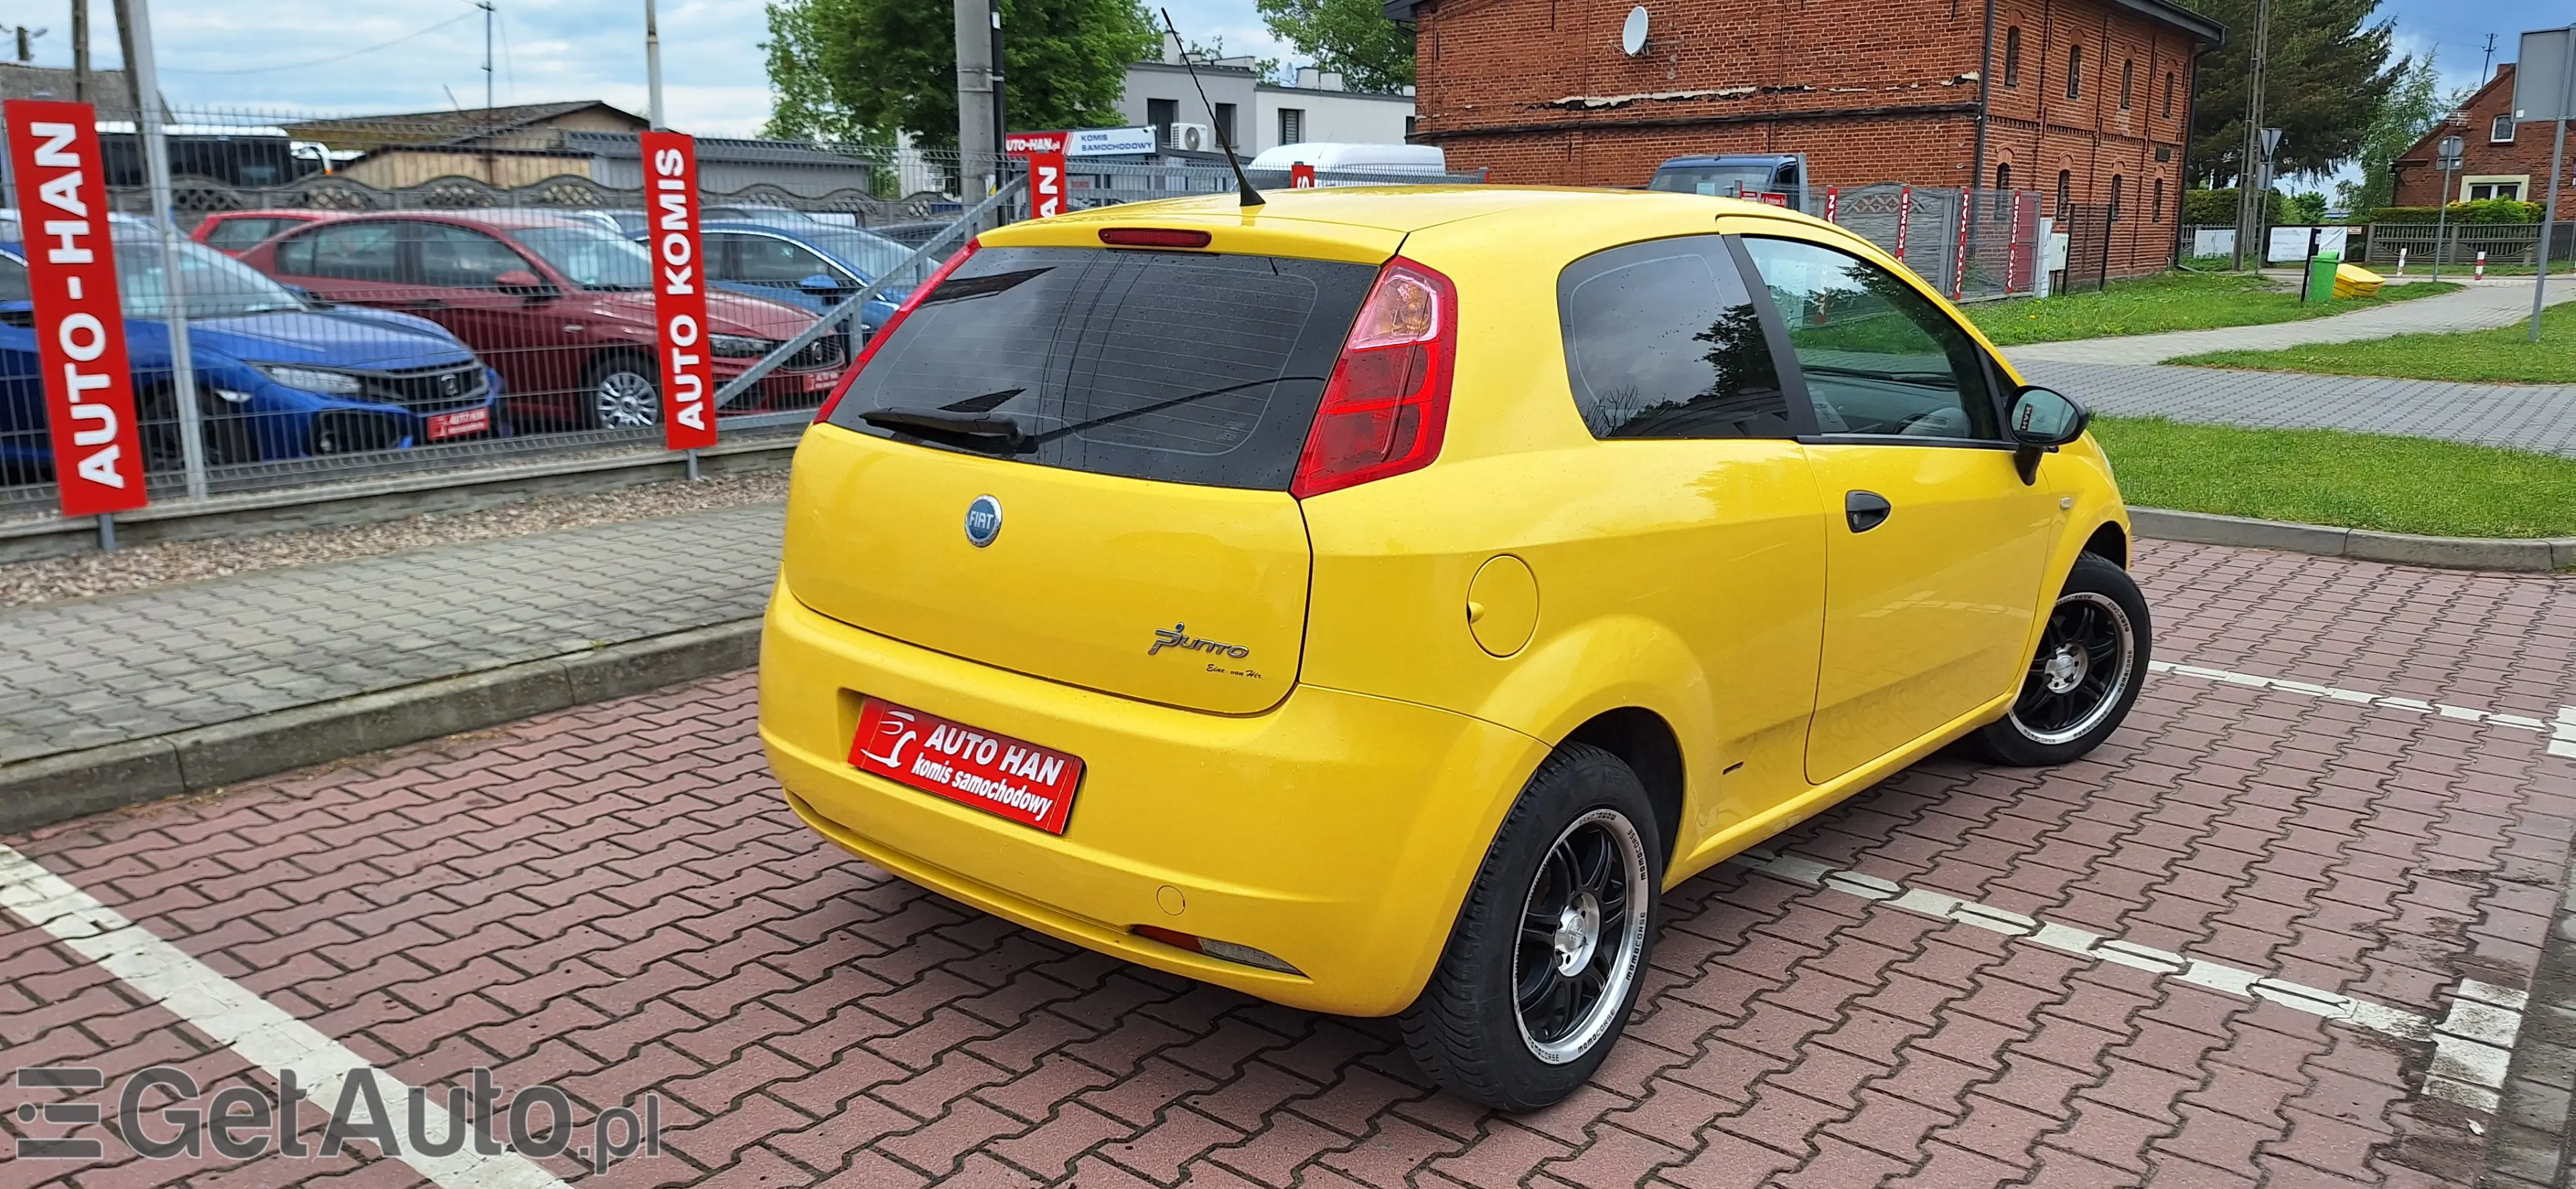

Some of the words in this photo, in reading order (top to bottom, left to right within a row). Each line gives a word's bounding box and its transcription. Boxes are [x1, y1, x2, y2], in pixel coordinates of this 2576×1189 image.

[1006, 137, 1061, 152] UTO-HAN.pl
[1081, 142, 1152, 152] SAMOCHODOWY
[30, 122, 93, 264] HAN
[1038, 166, 1059, 217] AN
[1827, 194, 1835, 224] AN
[1961, 194, 1969, 232] HAN
[655, 148, 694, 295] KOMIS
[1898, 192, 1909, 249] KOMIS
[2007, 249, 2015, 288] AUTO
[2011, 195, 2020, 243] KOMIS
[59, 313, 125, 489] AUTO
[669, 315, 705, 431] AUTO
[969, 510, 994, 529] FIAT
[1206, 664, 1226, 673] Eine
[924, 724, 998, 765] AUTO
[998, 745, 1065, 787] HAN
[911, 752, 953, 784] komis
[951, 771, 1053, 822] samochodowy
